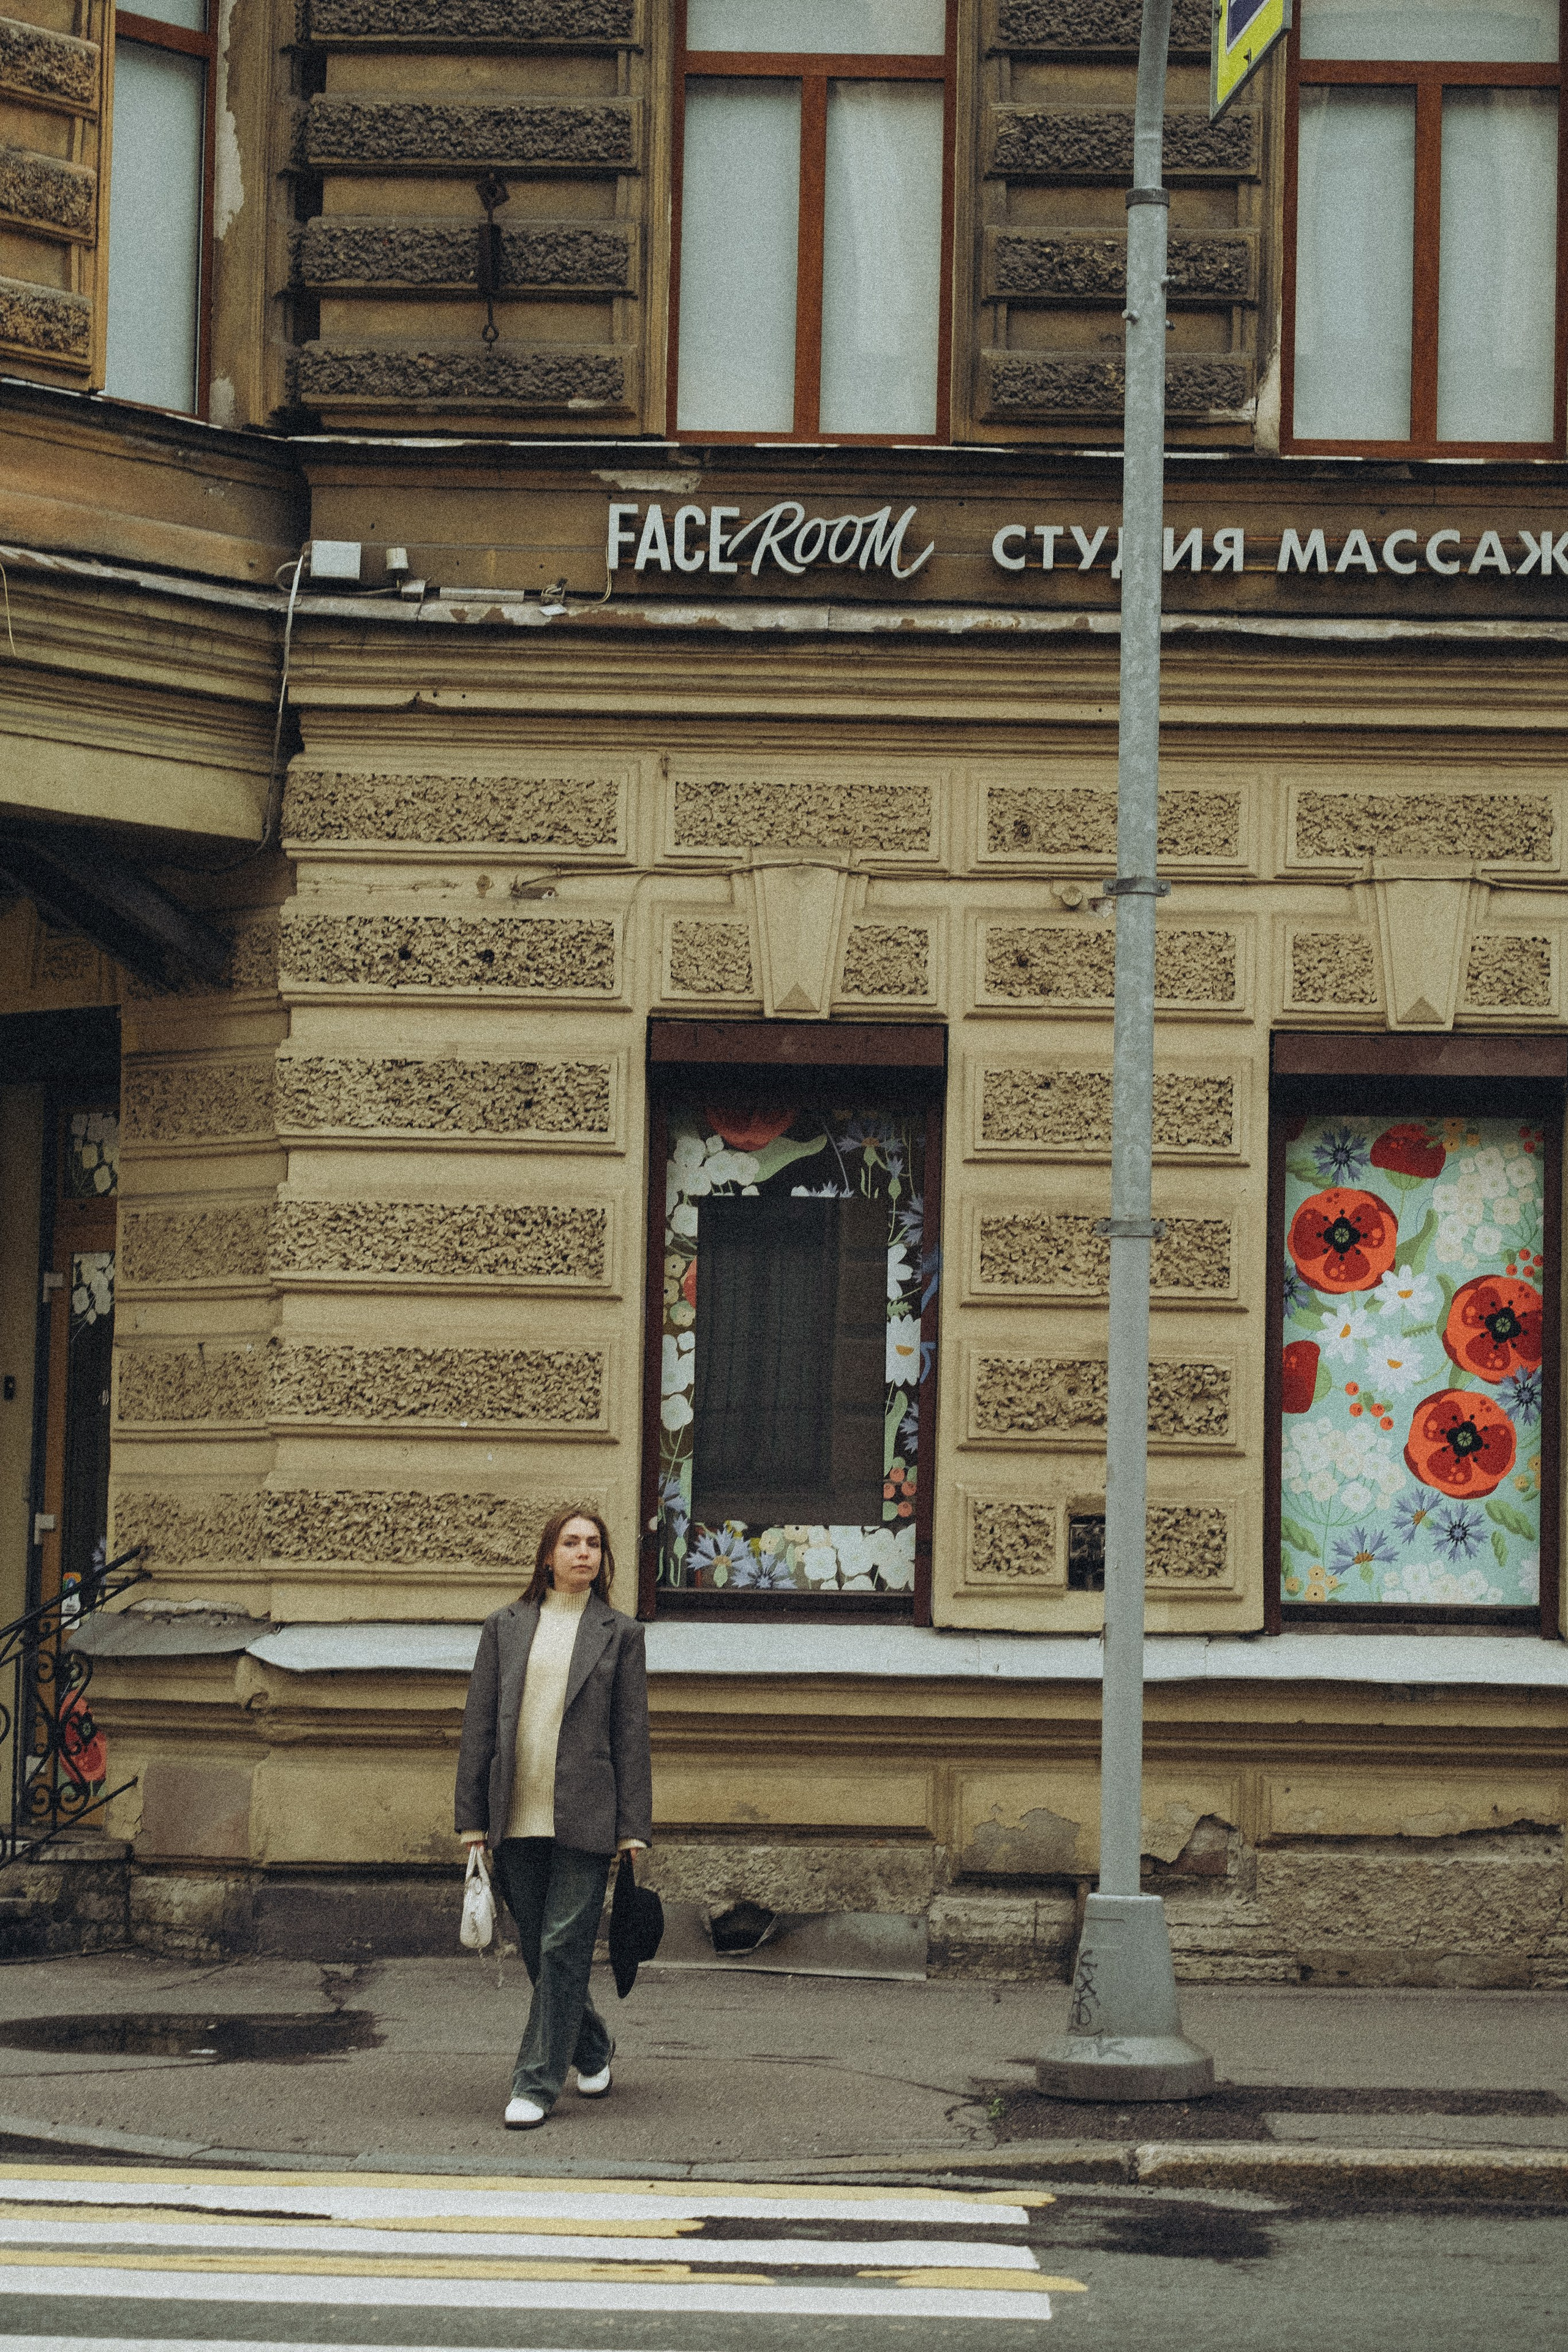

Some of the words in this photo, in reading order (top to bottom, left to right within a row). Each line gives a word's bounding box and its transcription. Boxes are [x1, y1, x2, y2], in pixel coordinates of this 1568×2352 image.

[606, 503, 740, 573] FACE
[991, 524, 1245, 579] СТУИЯ
[1276, 527, 1568, 575] МАССАЖ
